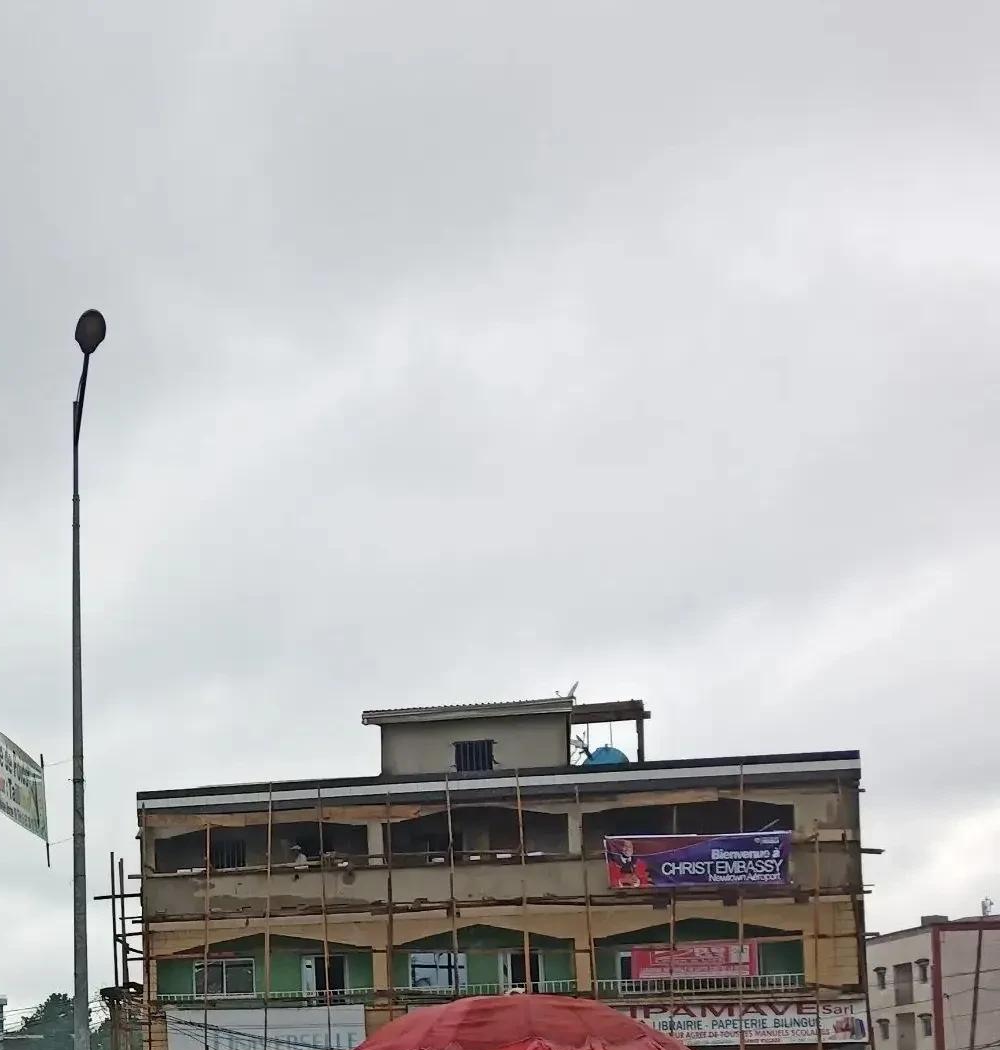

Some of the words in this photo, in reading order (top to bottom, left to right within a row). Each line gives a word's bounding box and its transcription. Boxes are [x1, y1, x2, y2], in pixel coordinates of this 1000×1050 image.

[711, 848, 771, 860] Bienvenue
[661, 861, 715, 876] CHRIST
[716, 859, 783, 875] EMBASSY
[709, 873, 746, 882] Newtown
[822, 1004, 854, 1015] Sarl
[653, 1019, 702, 1031] LIBRAIRIE
[711, 1018, 767, 1030] PAPETERIE
